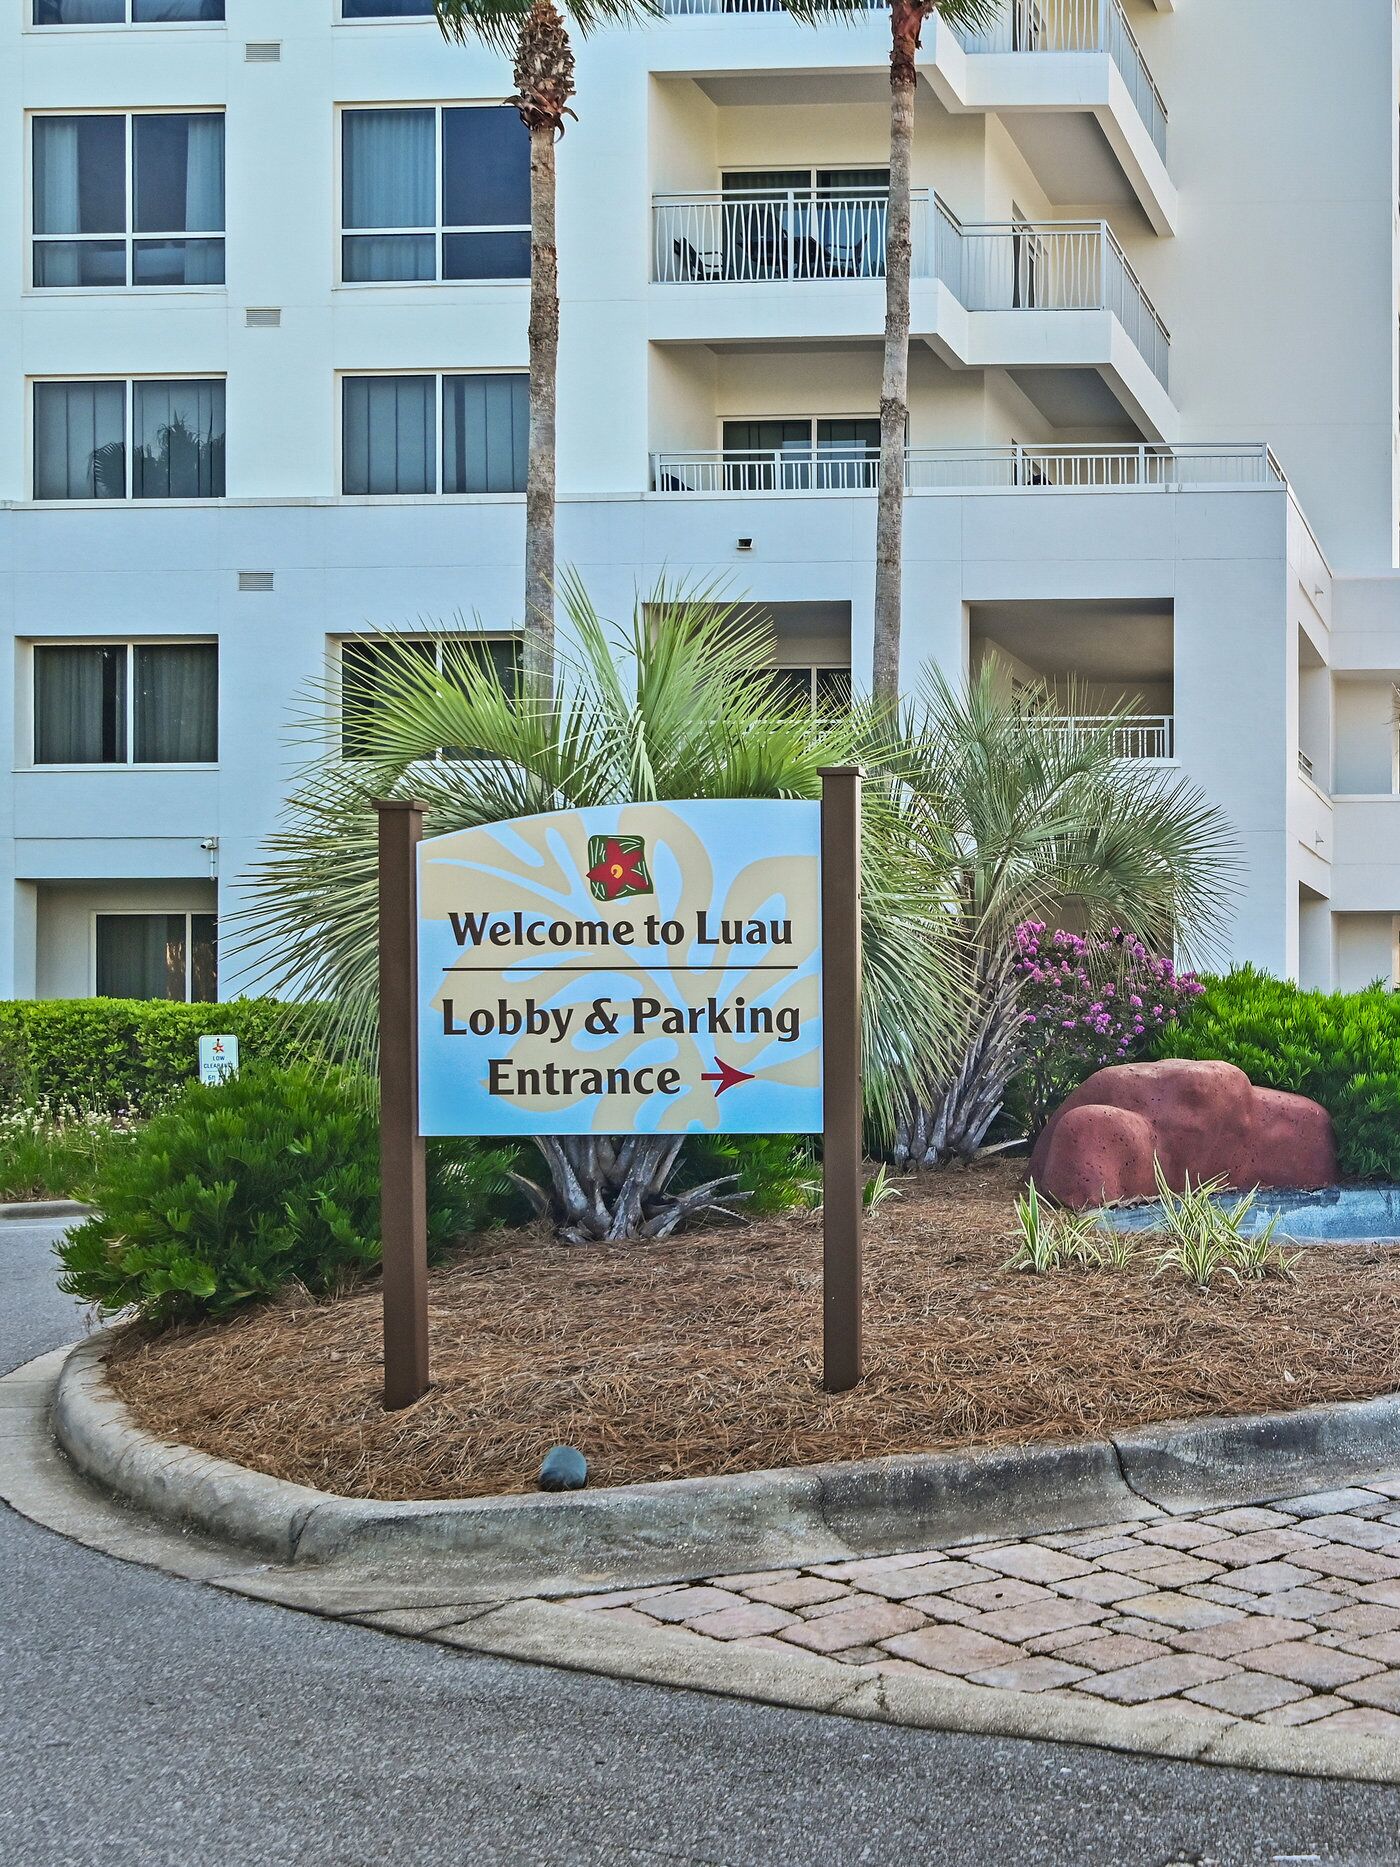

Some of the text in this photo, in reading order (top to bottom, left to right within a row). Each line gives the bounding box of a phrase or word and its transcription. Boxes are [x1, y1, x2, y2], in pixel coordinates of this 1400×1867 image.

[448, 911, 792, 946] Welcome to Luau
[443, 997, 799, 1043] Lobby & Parking
[488, 1059, 680, 1095] Entrance
